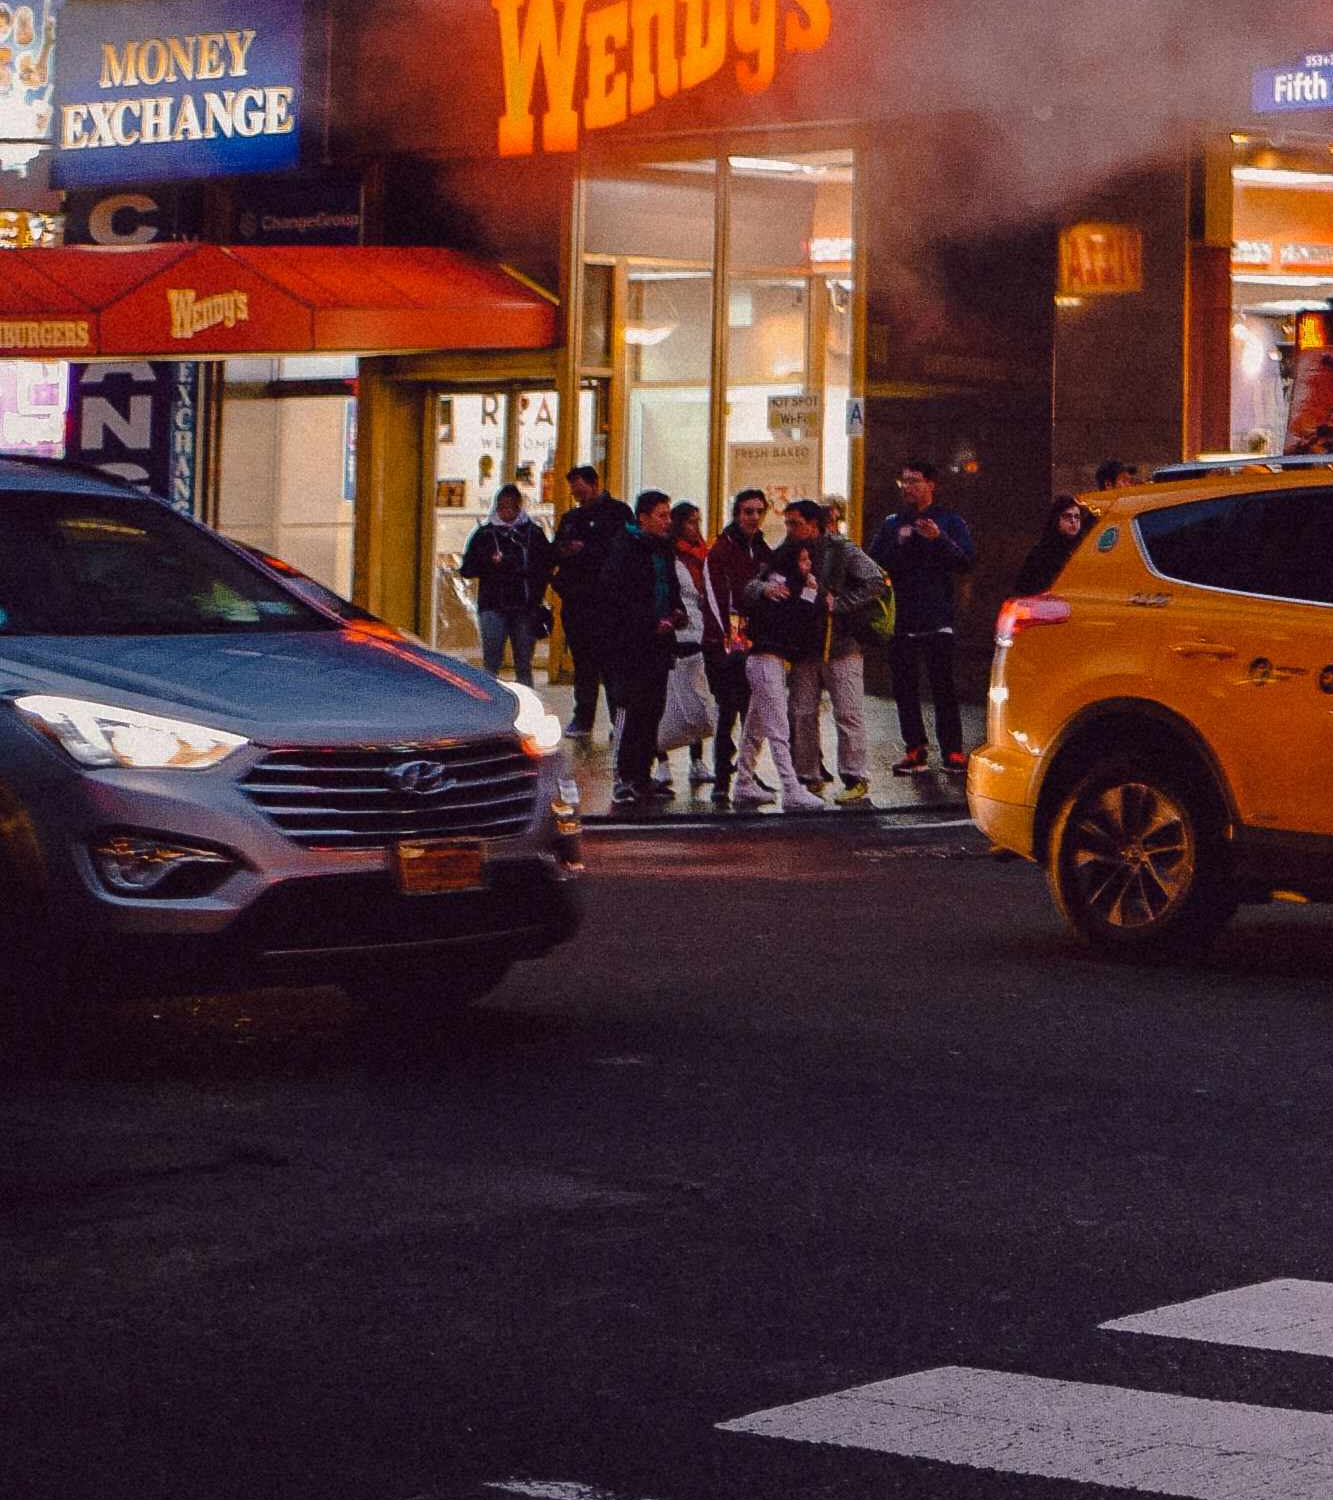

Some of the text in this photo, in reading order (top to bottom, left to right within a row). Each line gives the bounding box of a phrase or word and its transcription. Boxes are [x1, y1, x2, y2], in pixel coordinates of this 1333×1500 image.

[99, 30, 256, 88] MONEY
[1274, 72, 1327, 103] Fifth
[61, 85, 295, 150] EXCHANGE
[0, 320, 90, 349] BURGERS
[850, 403, 862, 425] A
[734, 447, 809, 460] FRESH BAKED
